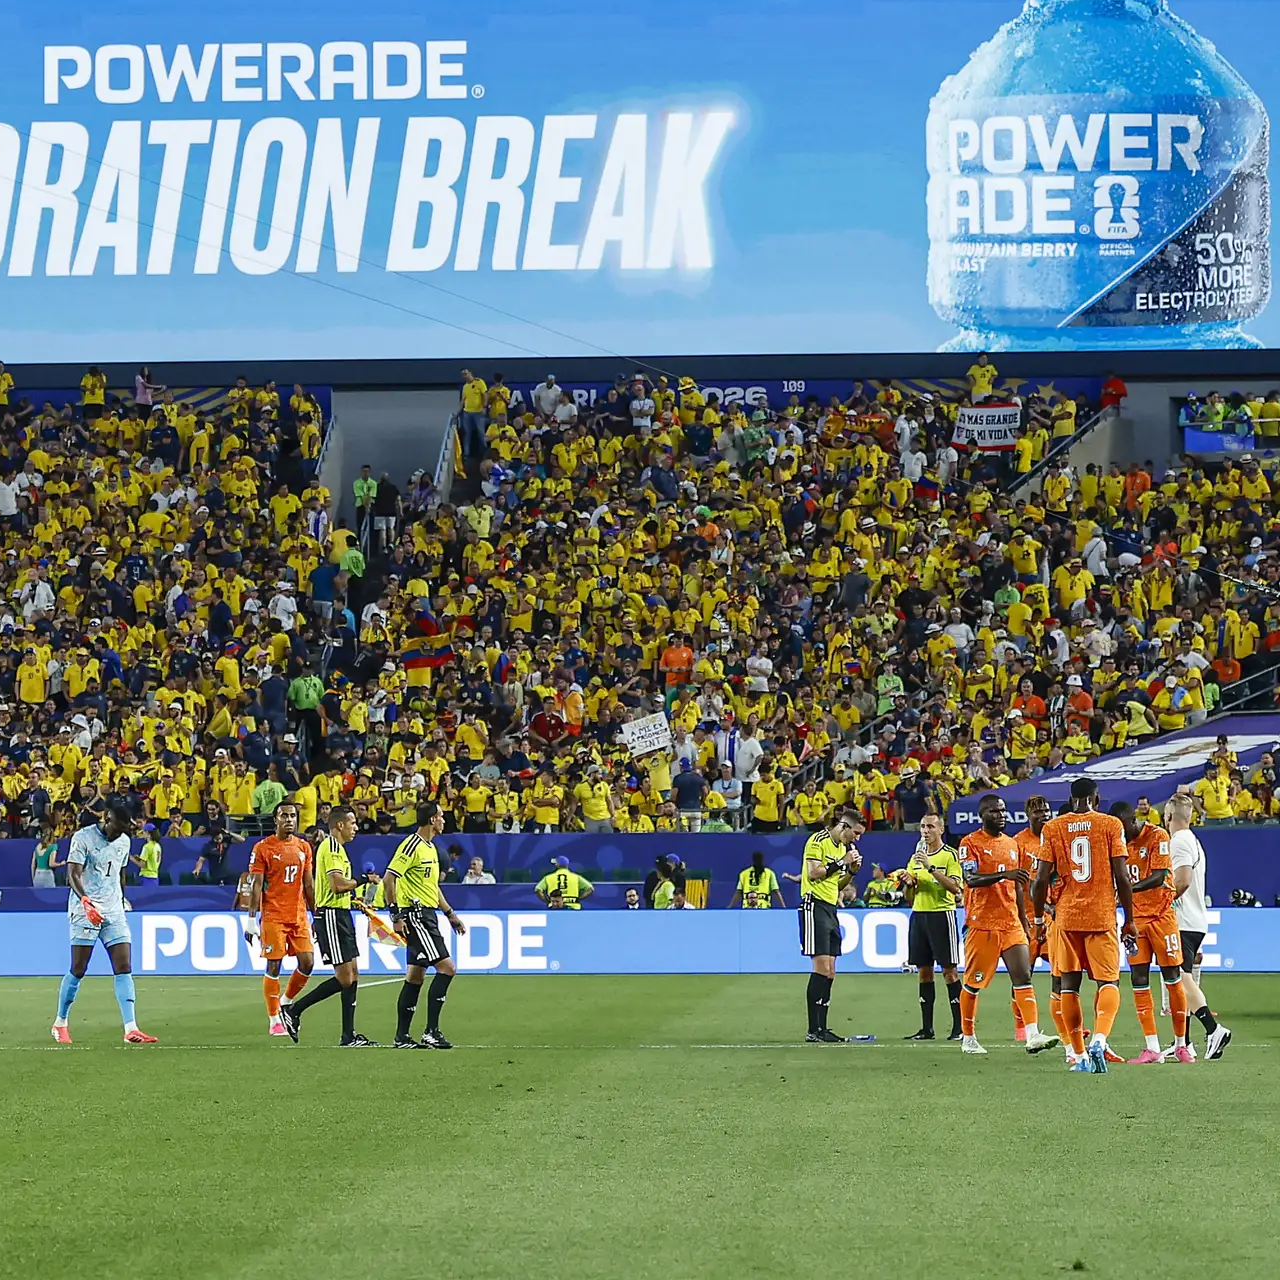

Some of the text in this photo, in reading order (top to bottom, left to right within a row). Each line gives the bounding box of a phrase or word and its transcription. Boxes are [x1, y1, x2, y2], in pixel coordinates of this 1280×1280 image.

[43, 40, 469, 104] POWERADE
[949, 113, 1204, 175] POWER
[386, 111, 734, 271] BREAK
[948, 176, 1075, 236] ADE
[1022, 243, 1077, 258] BERRY
[1100, 243, 1134, 251] OFFICIAL
[1195, 232, 1253, 265] 50%
[1198, 264, 1253, 290] MORE
[1136, 288, 1255, 310] ELECTROLYTES
[783, 380, 806, 393] 109
[985, 412, 1018, 425] GRANDE
[964, 429, 977, 439] DE
[989, 429, 1009, 440] VIDA
[1068, 822, 1092, 833] BONNY
[105, 861, 111, 877] 1
[1071, 836, 1092, 883] 9
[283, 865, 299, 884] 17
[1164, 933, 1180, 952] 19
